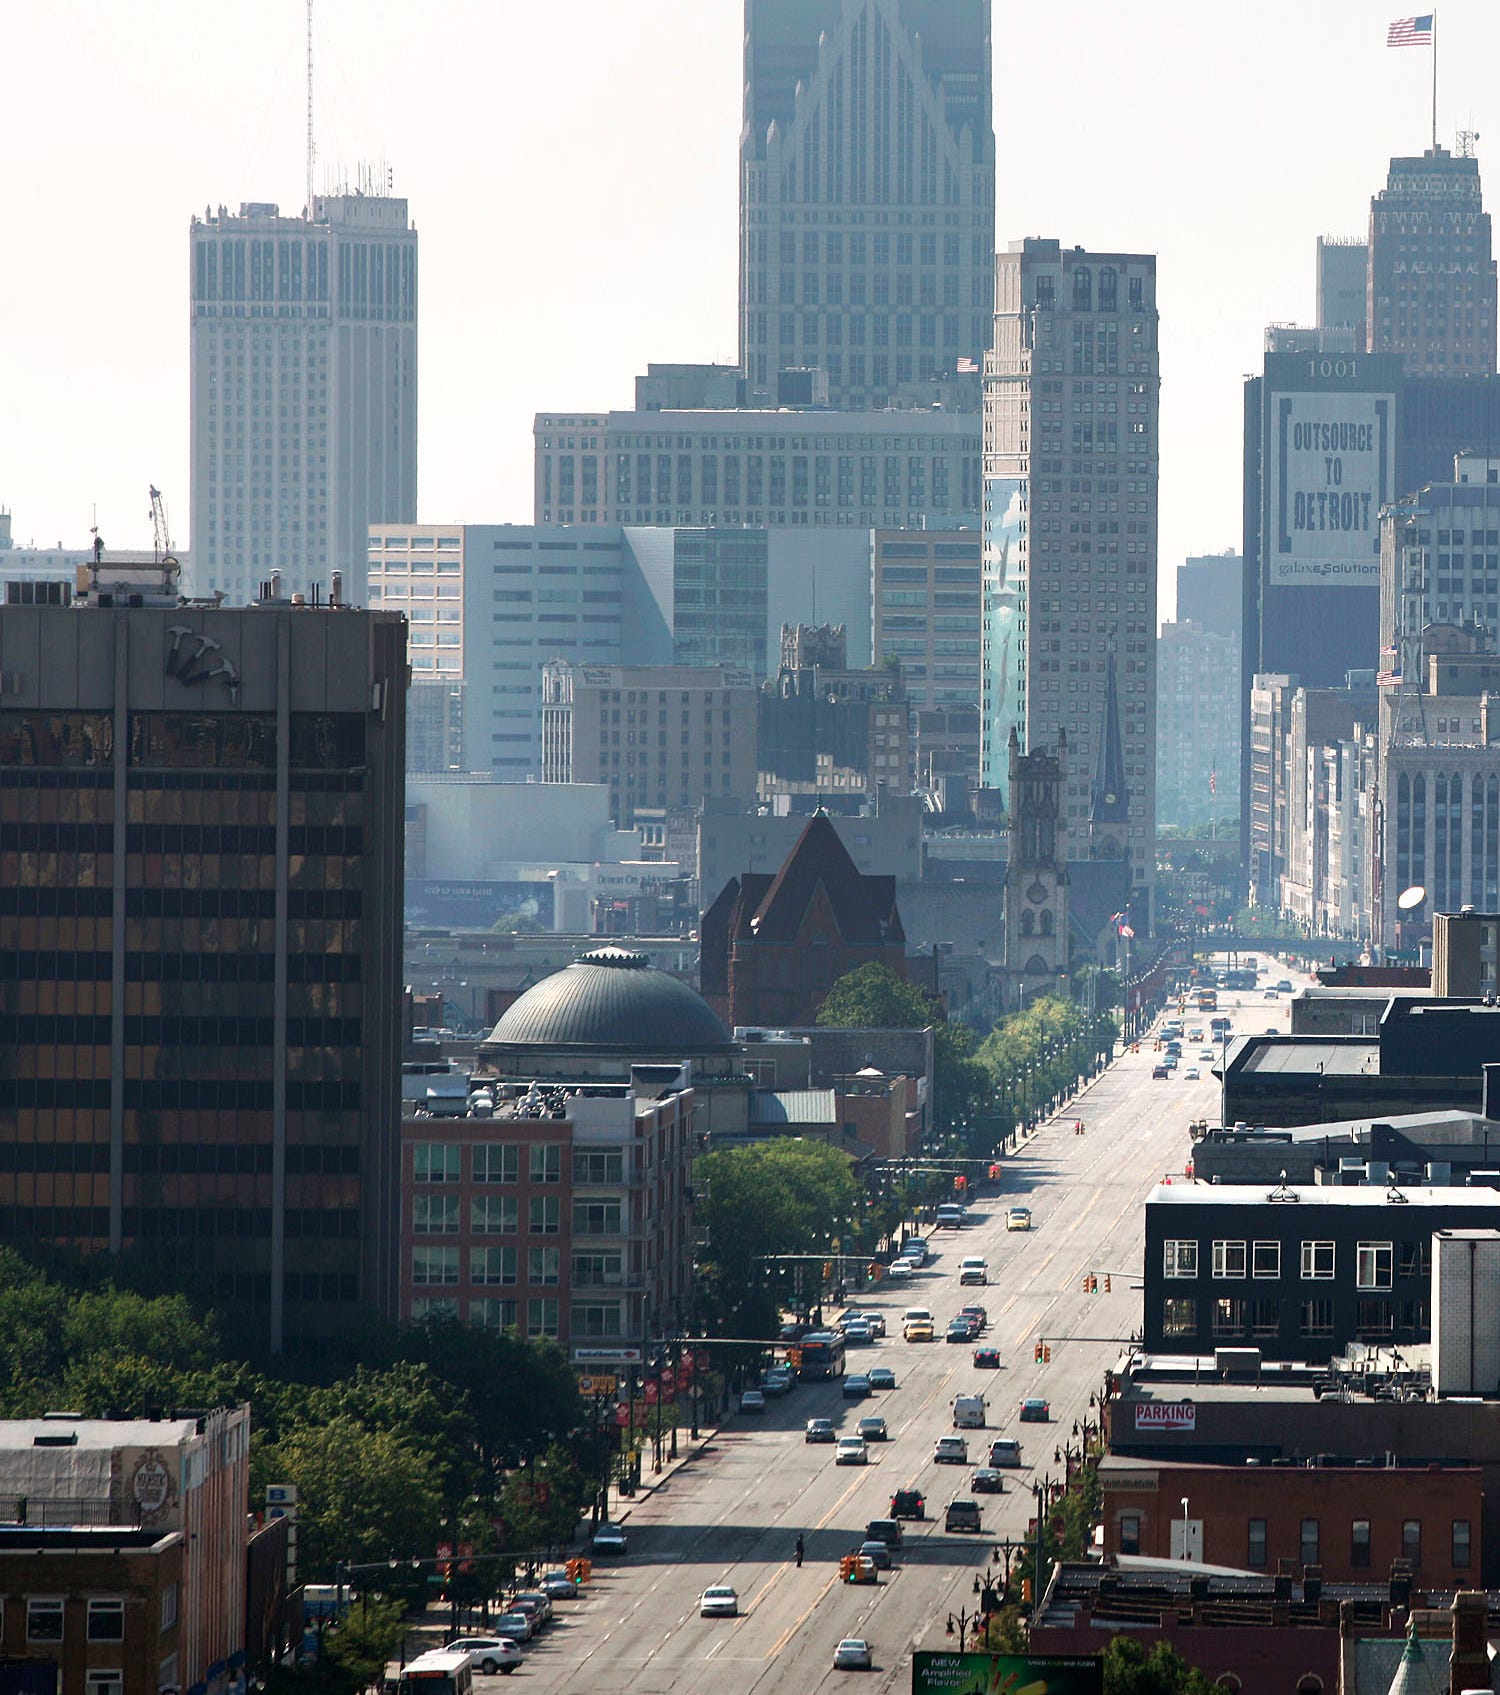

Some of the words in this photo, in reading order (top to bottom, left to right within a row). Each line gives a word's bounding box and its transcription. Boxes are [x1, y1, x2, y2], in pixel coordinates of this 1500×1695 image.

[1307, 359, 1359, 378] 1001
[1294, 422, 1373, 451] OUTSOURCE
[1325, 457, 1342, 486] TO
[1294, 490, 1372, 531] DETROIT
[1136, 1406, 1195, 1420] PARKING
[930, 1658, 961, 1667] NEW
[920, 1667, 972, 1679] Amplified
